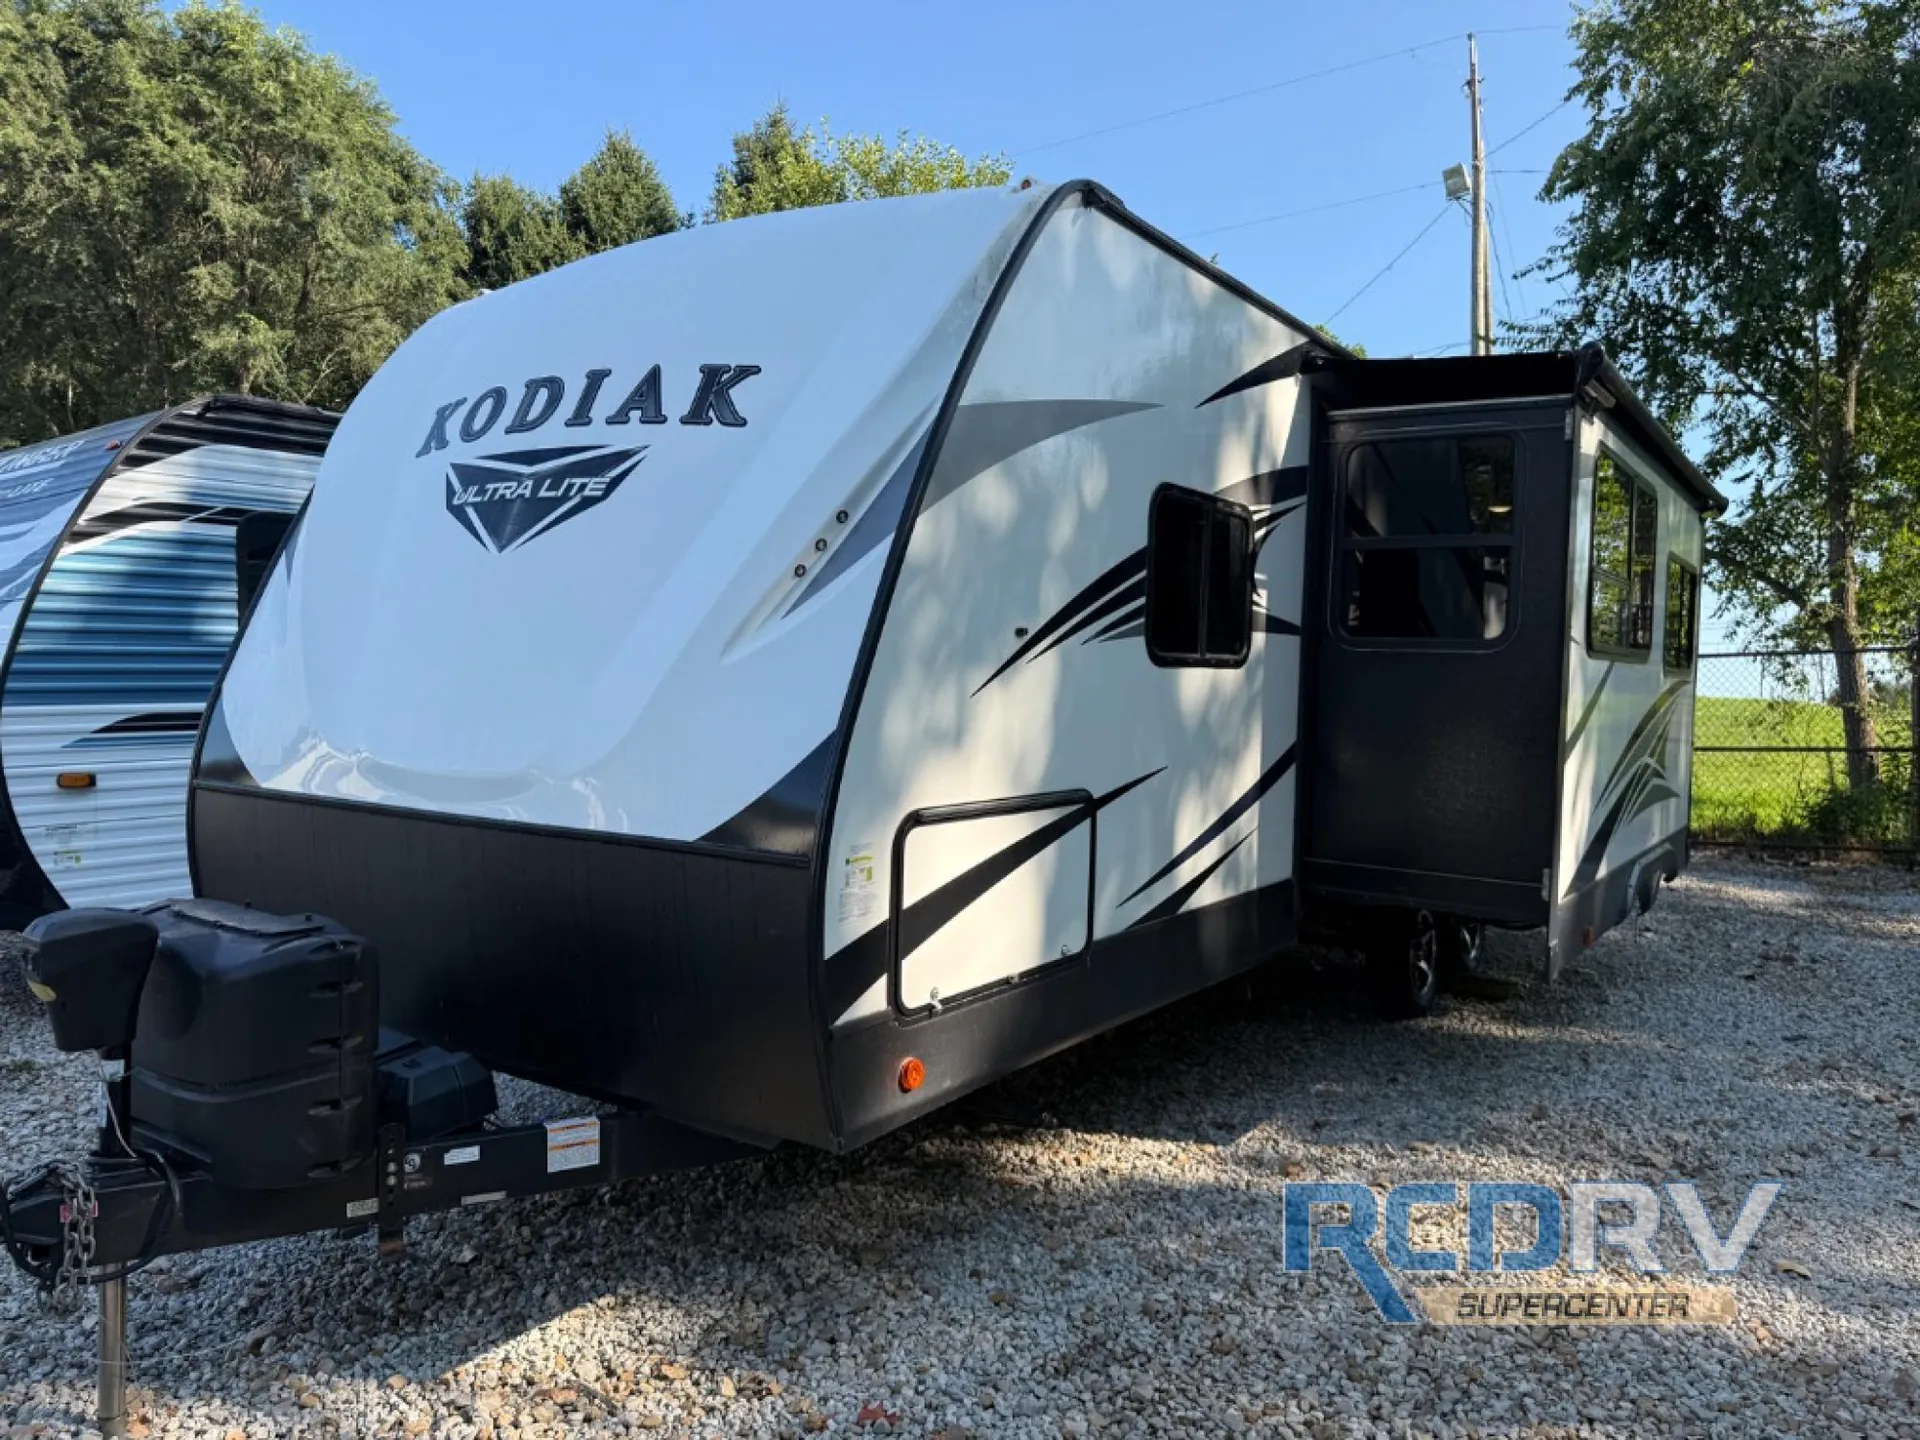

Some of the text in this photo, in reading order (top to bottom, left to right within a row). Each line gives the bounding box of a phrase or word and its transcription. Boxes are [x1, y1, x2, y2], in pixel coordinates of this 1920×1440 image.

[415, 363, 762, 459] KODIAK
[452, 477, 611, 506] ULTRA LITE
